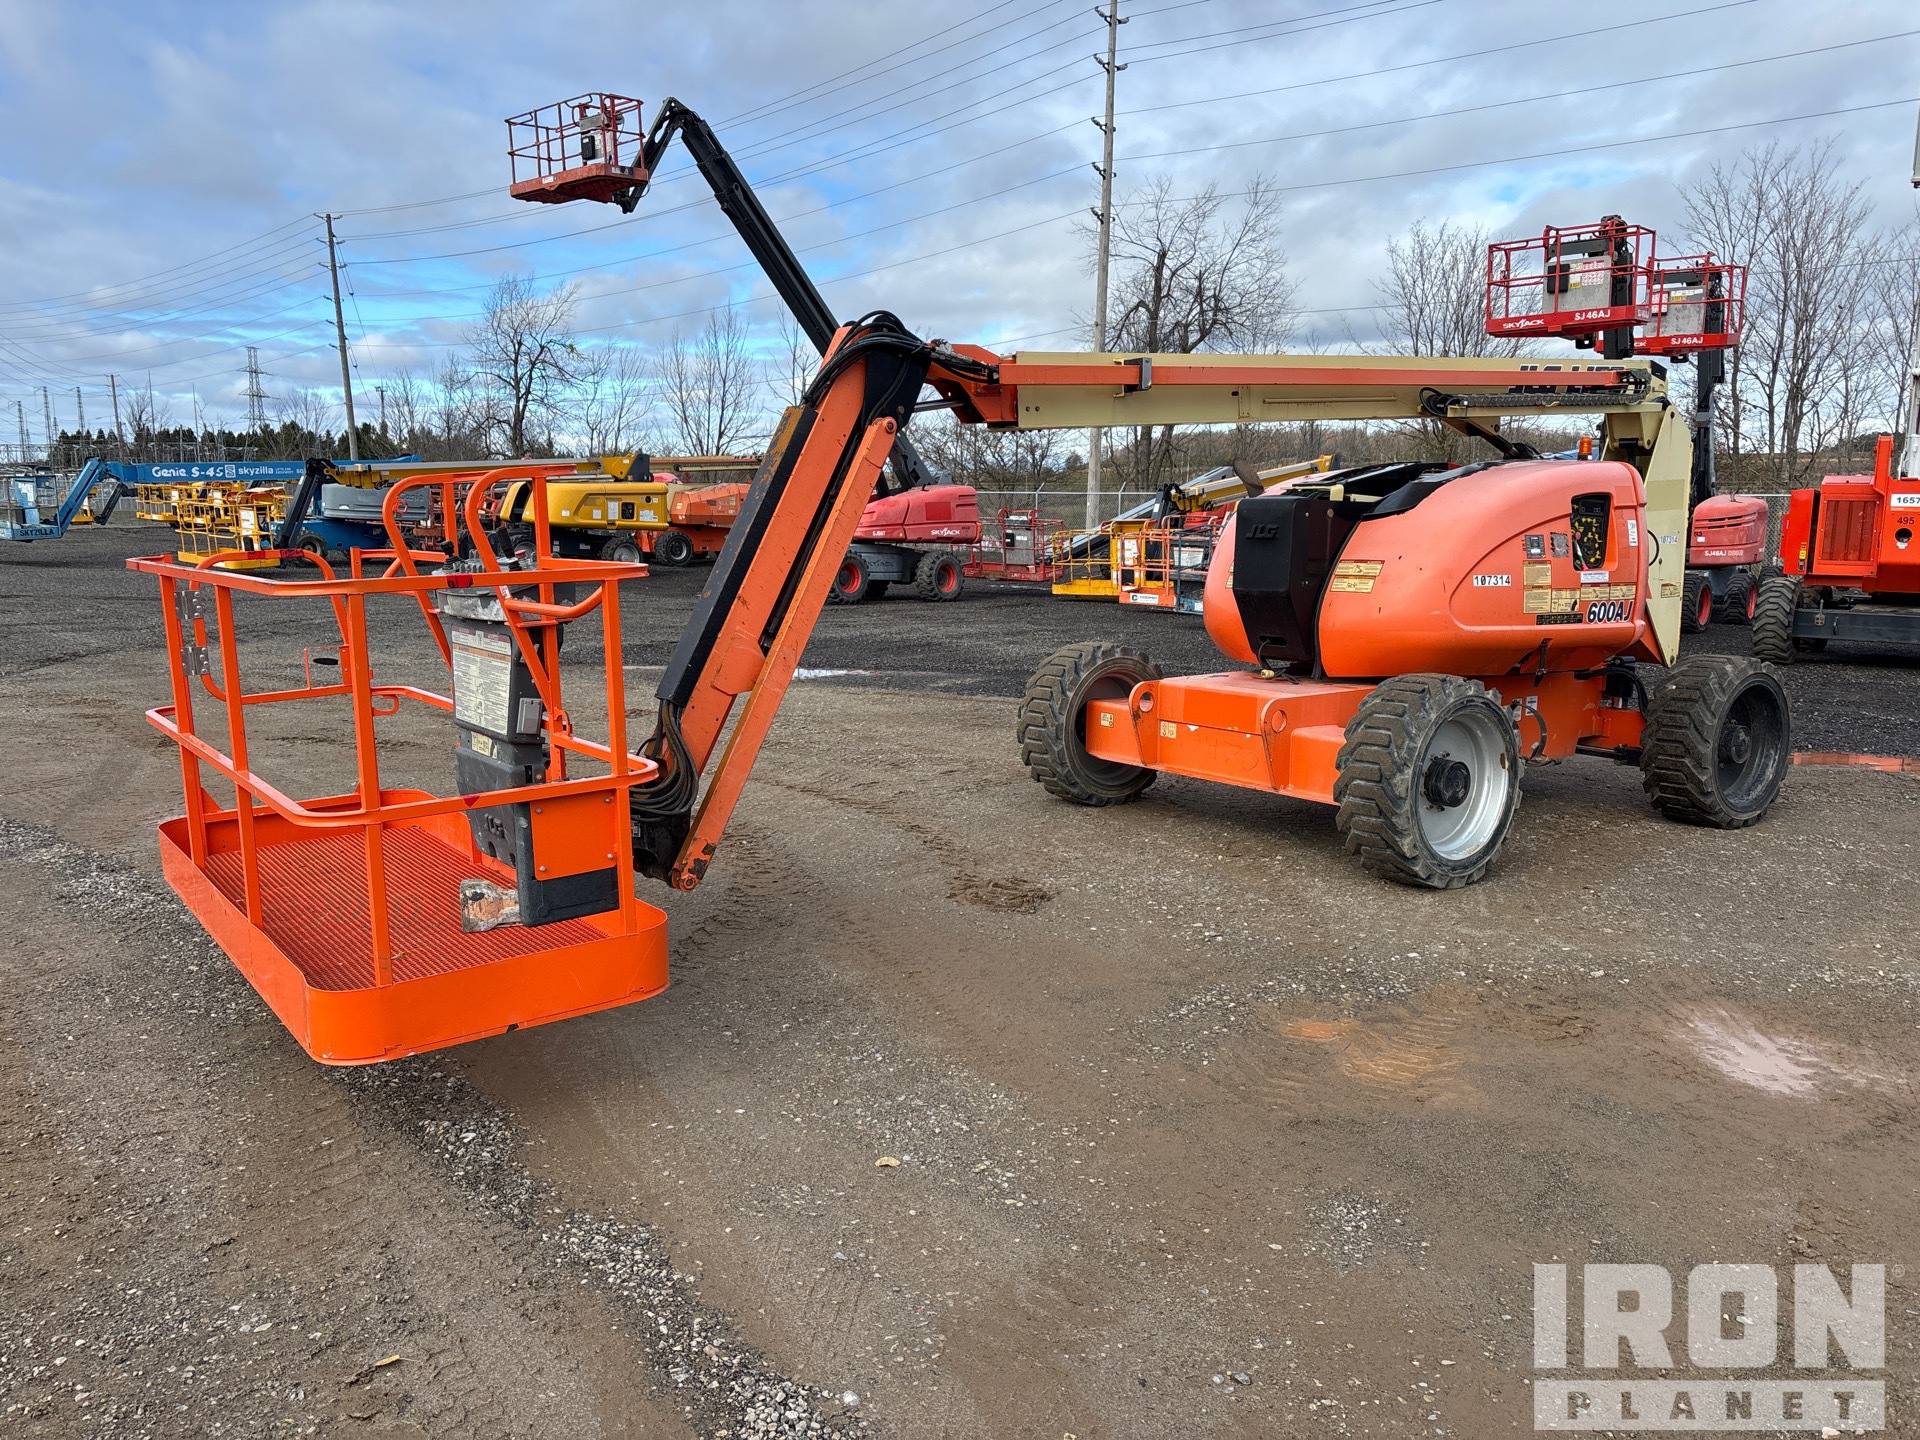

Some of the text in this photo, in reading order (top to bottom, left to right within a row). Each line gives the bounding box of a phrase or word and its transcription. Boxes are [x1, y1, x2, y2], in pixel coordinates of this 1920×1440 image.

[1502, 318, 1545, 330] SKYJACK
[151, 466, 224, 478] Genie S-45
[238, 465, 274, 477] skyzilla
[1896, 516, 1915, 525] 495
[20, 529, 55, 537] SKYZILLA
[930, 526, 961, 537] SKYJACK
[1246, 524, 1280, 540] JLG
[1474, 575, 1511, 586] 107314
[1587, 601, 1634, 624] 600AJ
